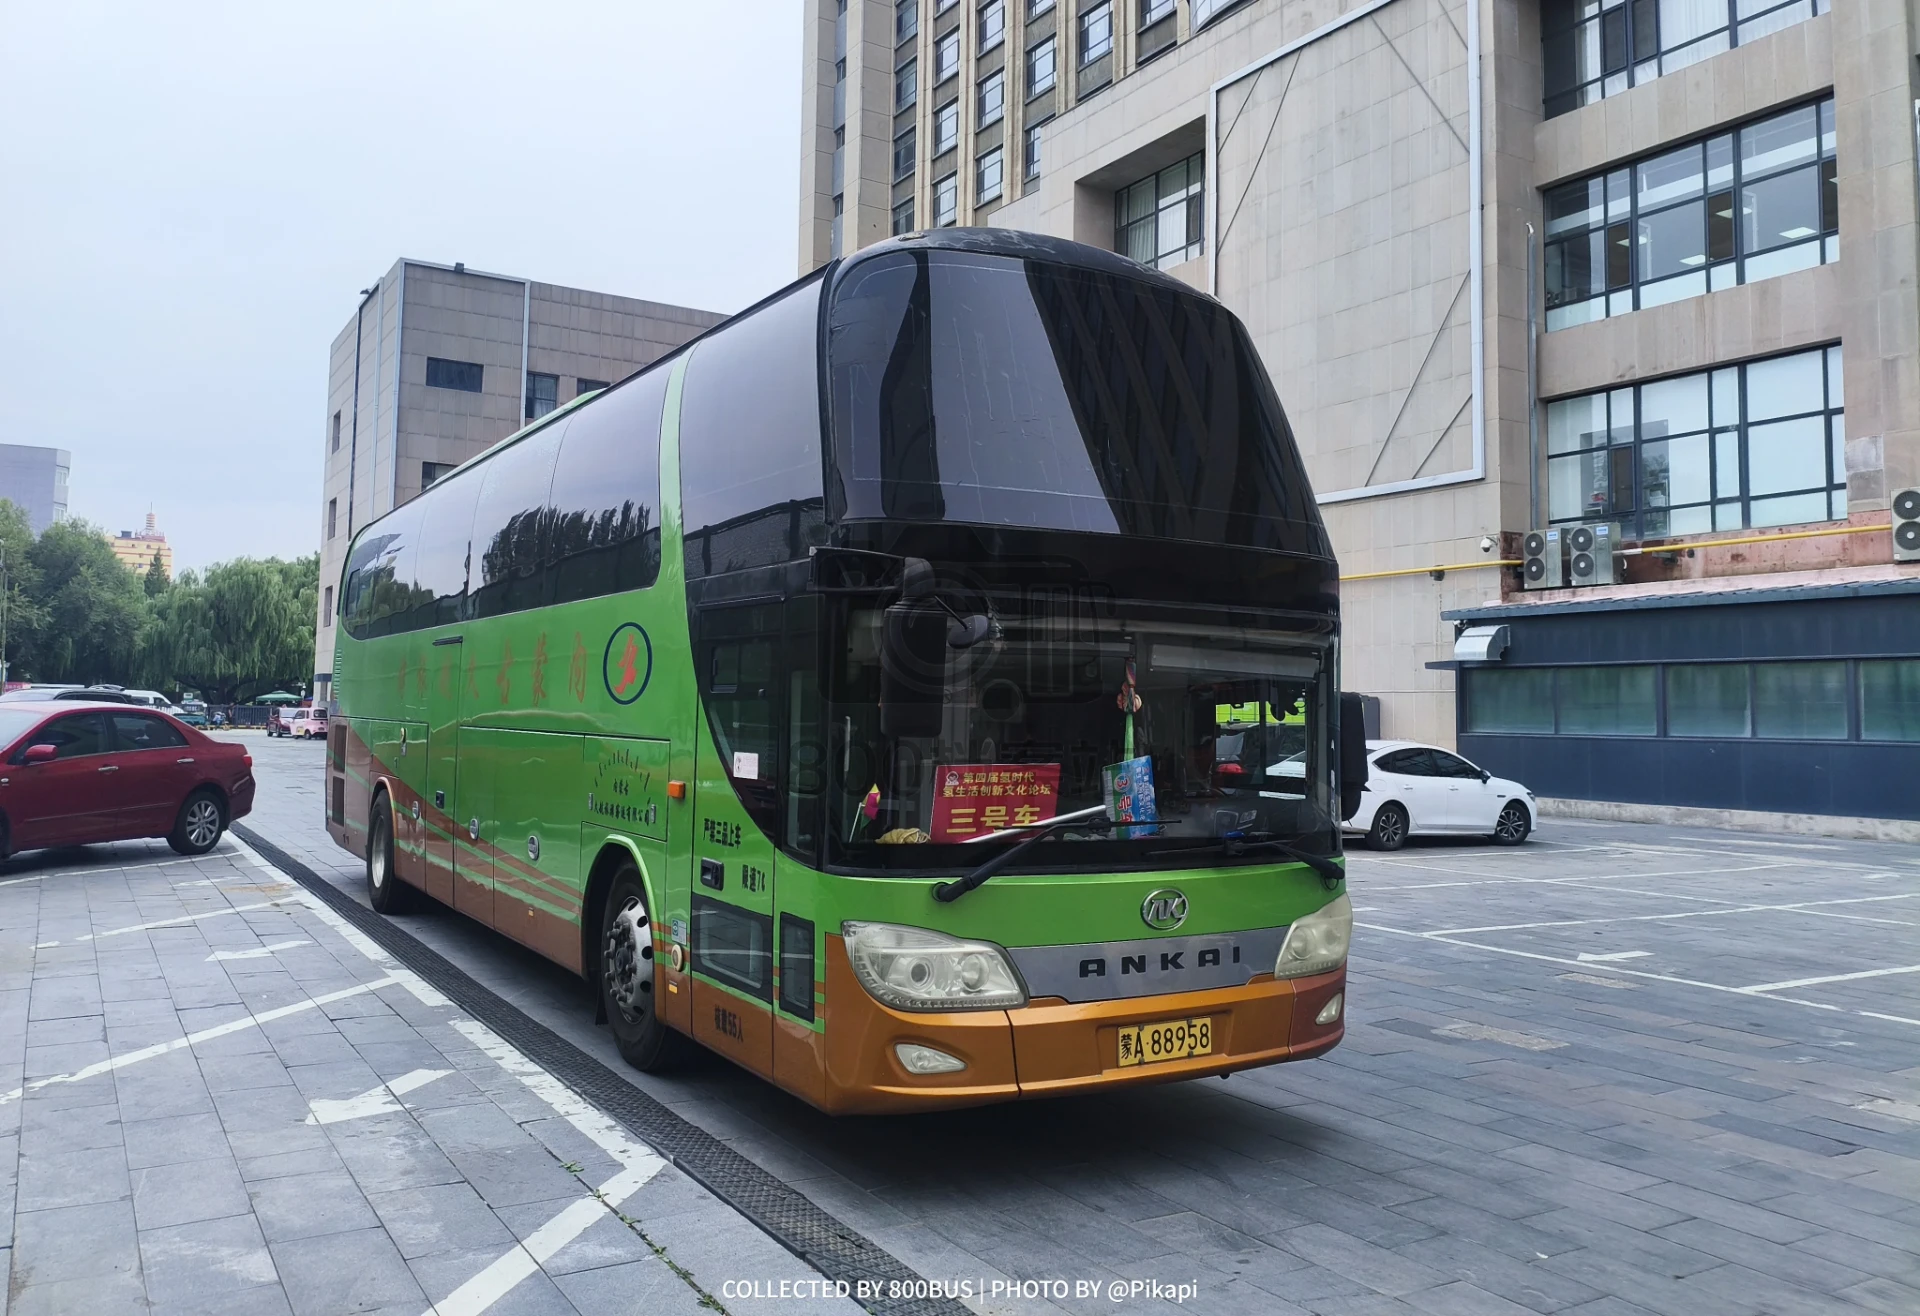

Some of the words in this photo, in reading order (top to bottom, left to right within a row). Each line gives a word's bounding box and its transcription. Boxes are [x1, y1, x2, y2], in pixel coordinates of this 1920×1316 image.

[962, 771, 1035, 784] 第四届氢时代
[942, 784, 1052, 798] 氢生活创新文化论坛
[946, 804, 1040, 834] 三号车
[1079, 946, 1240, 978] ANKAI
